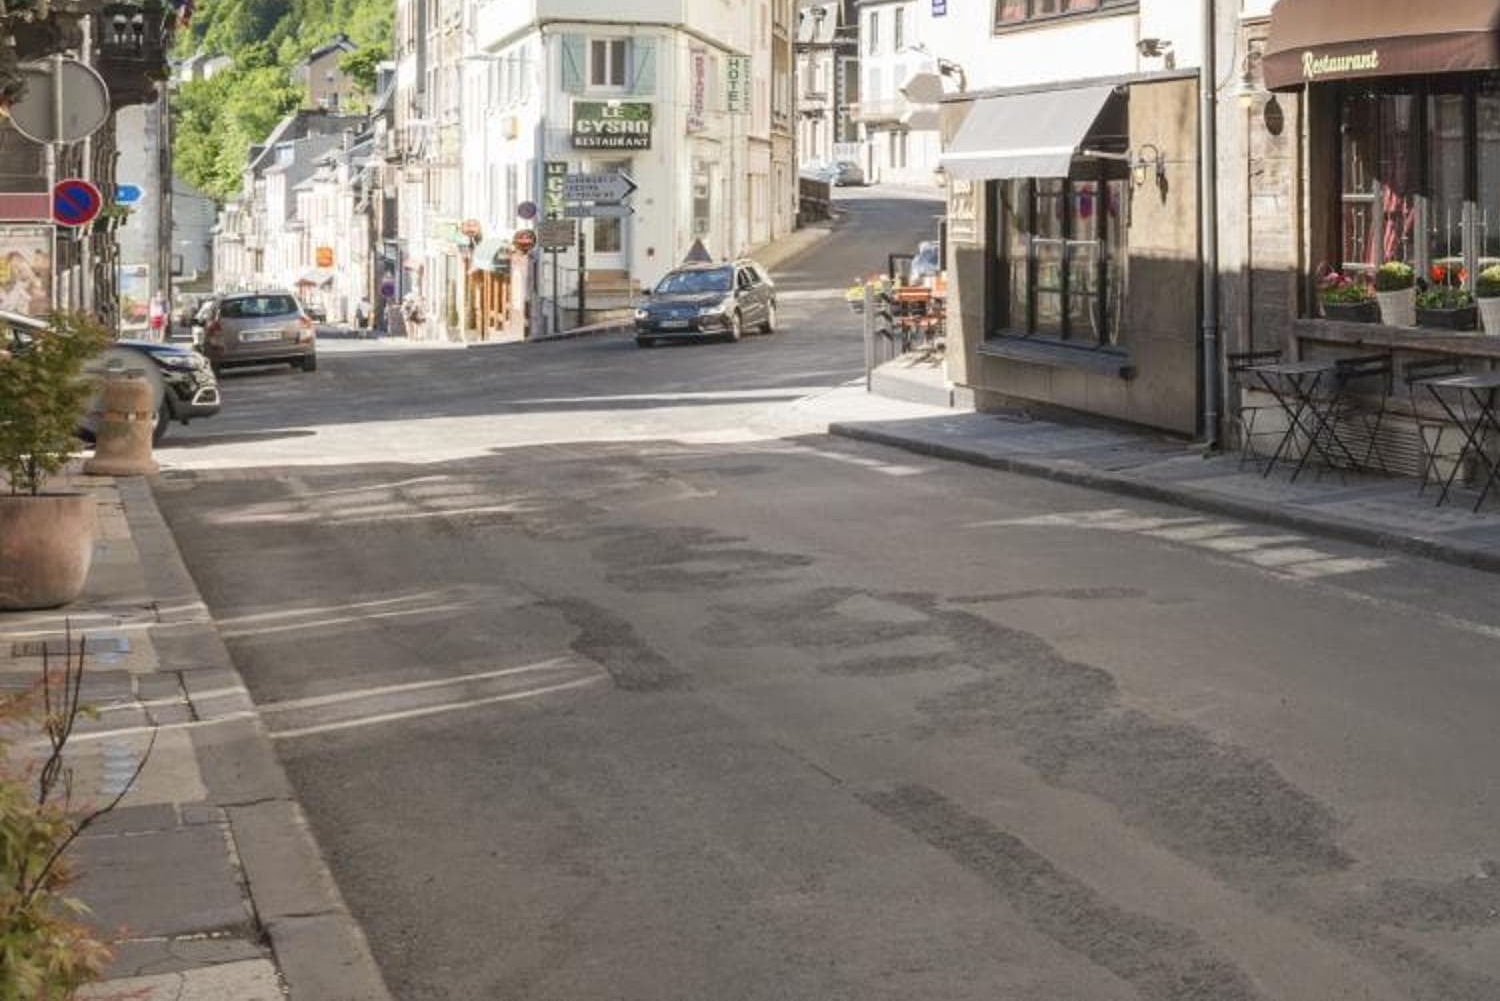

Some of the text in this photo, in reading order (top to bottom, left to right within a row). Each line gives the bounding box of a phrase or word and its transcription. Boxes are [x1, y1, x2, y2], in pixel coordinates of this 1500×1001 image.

[1301, 49, 1379, 79] Restaurant
[601, 106, 625, 118] LE
[575, 137, 649, 147] RESTAURANT
